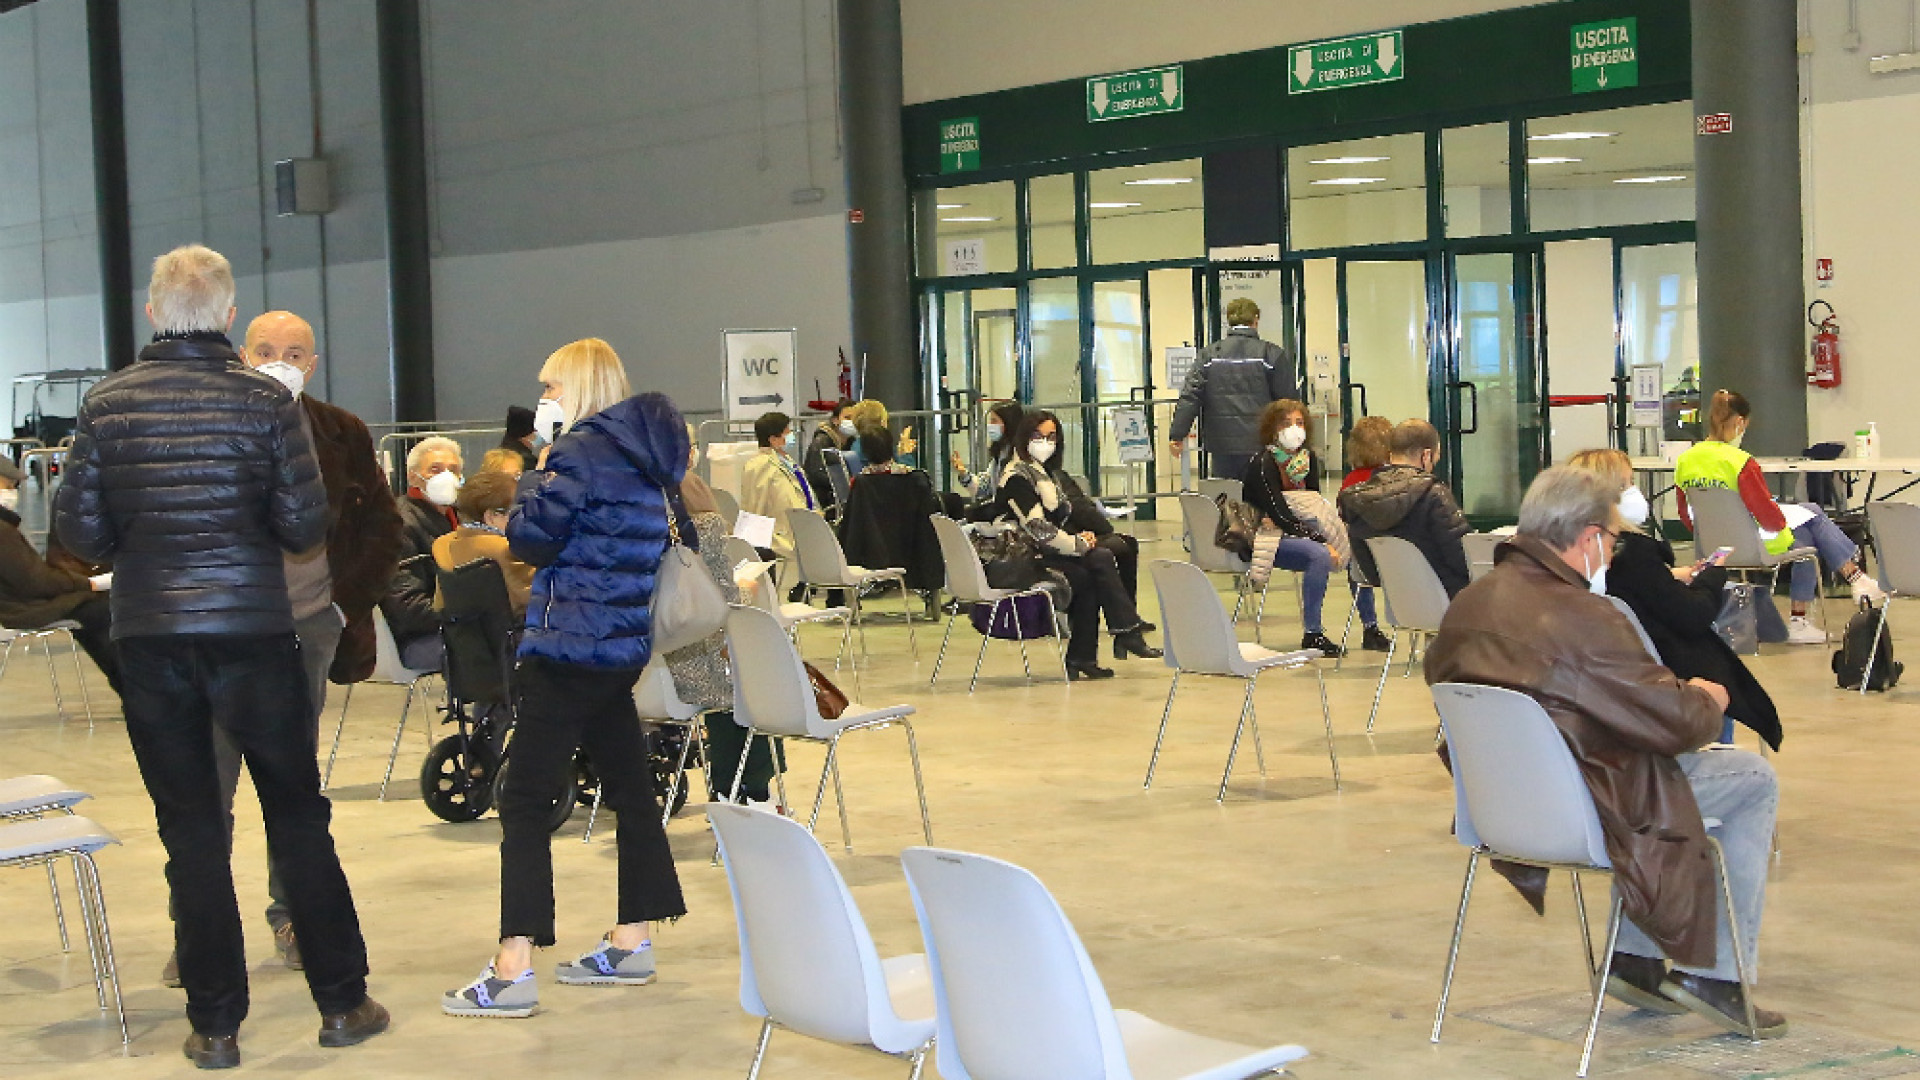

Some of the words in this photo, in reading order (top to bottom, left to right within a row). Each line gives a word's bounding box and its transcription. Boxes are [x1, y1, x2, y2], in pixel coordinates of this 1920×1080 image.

[1575, 26, 1629, 50] USCITA
[1316, 47, 1354, 62] USCITA
[1362, 43, 1372, 57] DI
[1572, 53, 1581, 69] DI
[742, 358, 779, 377] WC
